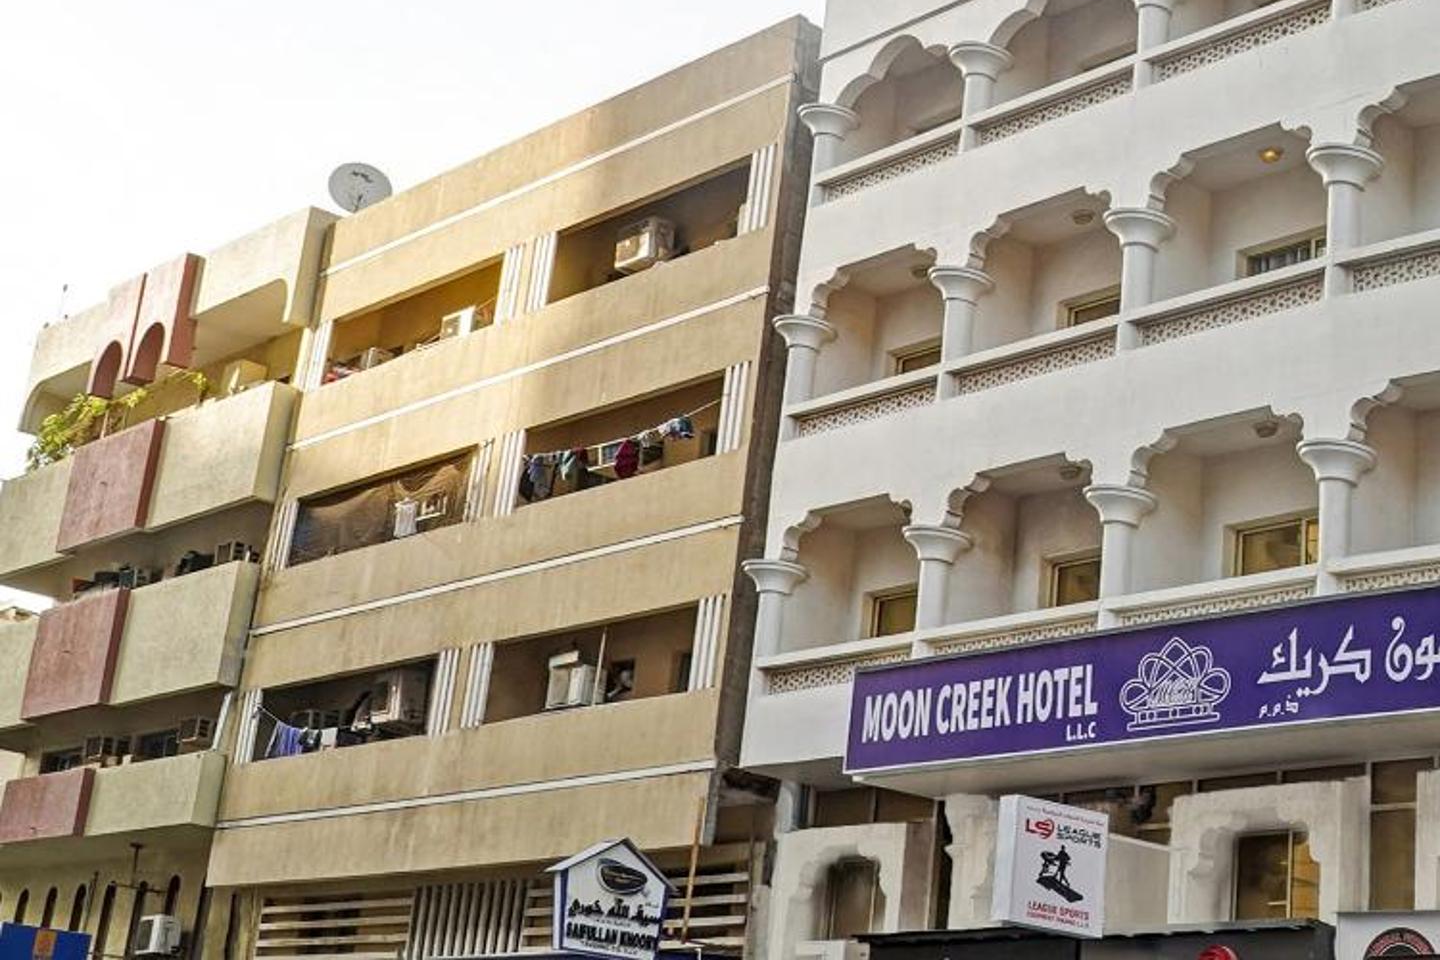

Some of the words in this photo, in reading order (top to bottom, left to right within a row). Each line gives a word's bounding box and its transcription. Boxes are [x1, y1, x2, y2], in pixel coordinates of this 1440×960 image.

[1257, 623, 1372, 697] كريك
[861, 687, 932, 743] MOON
[936, 676, 1013, 734] CREEK
[1016, 664, 1098, 724] HOTEL
[1057, 823, 1101, 839] LEAGUE
[1028, 900, 1057, 914] LEAGUE
[1060, 906, 1089, 921] SPORTS
